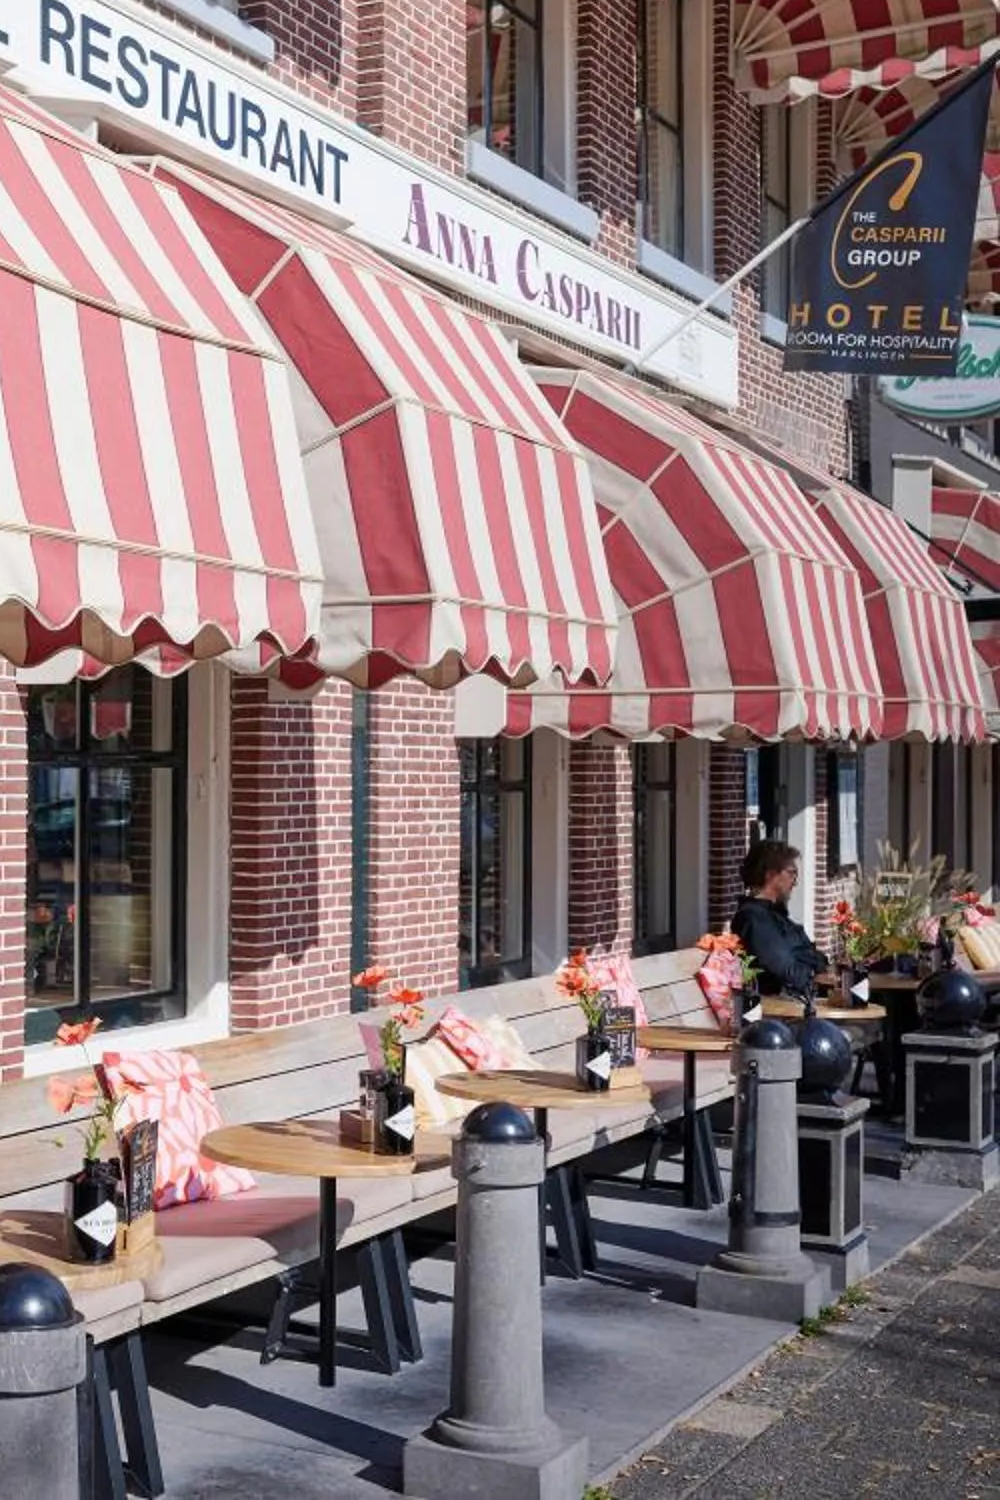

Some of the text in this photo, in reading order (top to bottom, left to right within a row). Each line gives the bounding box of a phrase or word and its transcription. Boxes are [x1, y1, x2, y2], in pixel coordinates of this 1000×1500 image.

[852, 211, 877, 223] THE
[851, 227, 946, 243] CASPARII
[847, 249, 921, 267] GROUP
[790, 301, 960, 333] HOTEL
[787, 331, 958, 350] ROOM FOR HOSPITALITY
[831, 349, 905, 360] HARLINGEN
